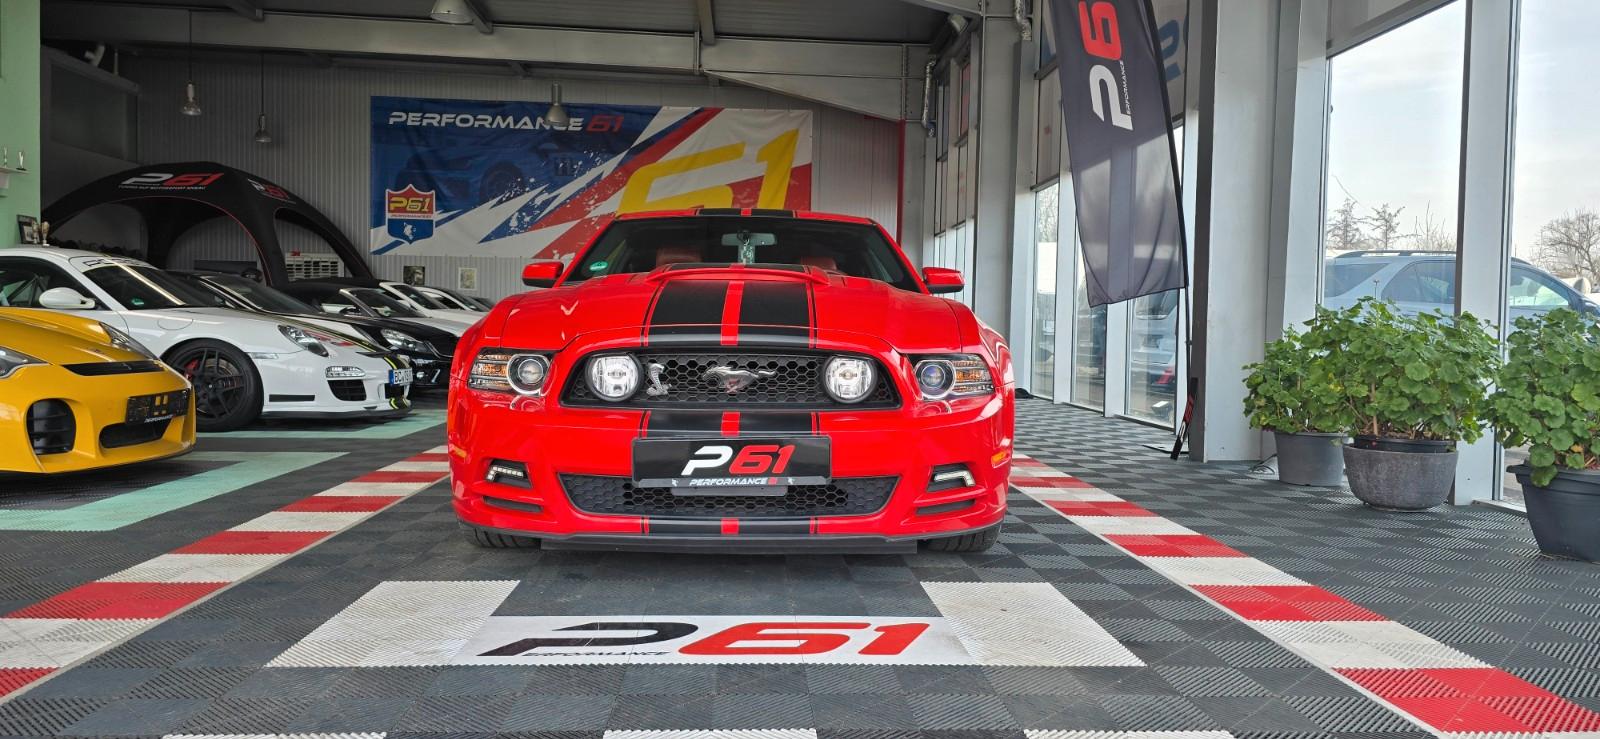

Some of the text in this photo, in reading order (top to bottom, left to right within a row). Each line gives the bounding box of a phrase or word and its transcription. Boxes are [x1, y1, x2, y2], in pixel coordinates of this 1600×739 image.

[587, 115, 624, 132] 61
[121, 173, 225, 185] P61
[390, 197, 430, 212] P61
[681, 445, 796, 476] P61
[690, 478, 767, 486] PERFORMANCE
[476, 622, 931, 655] P61
